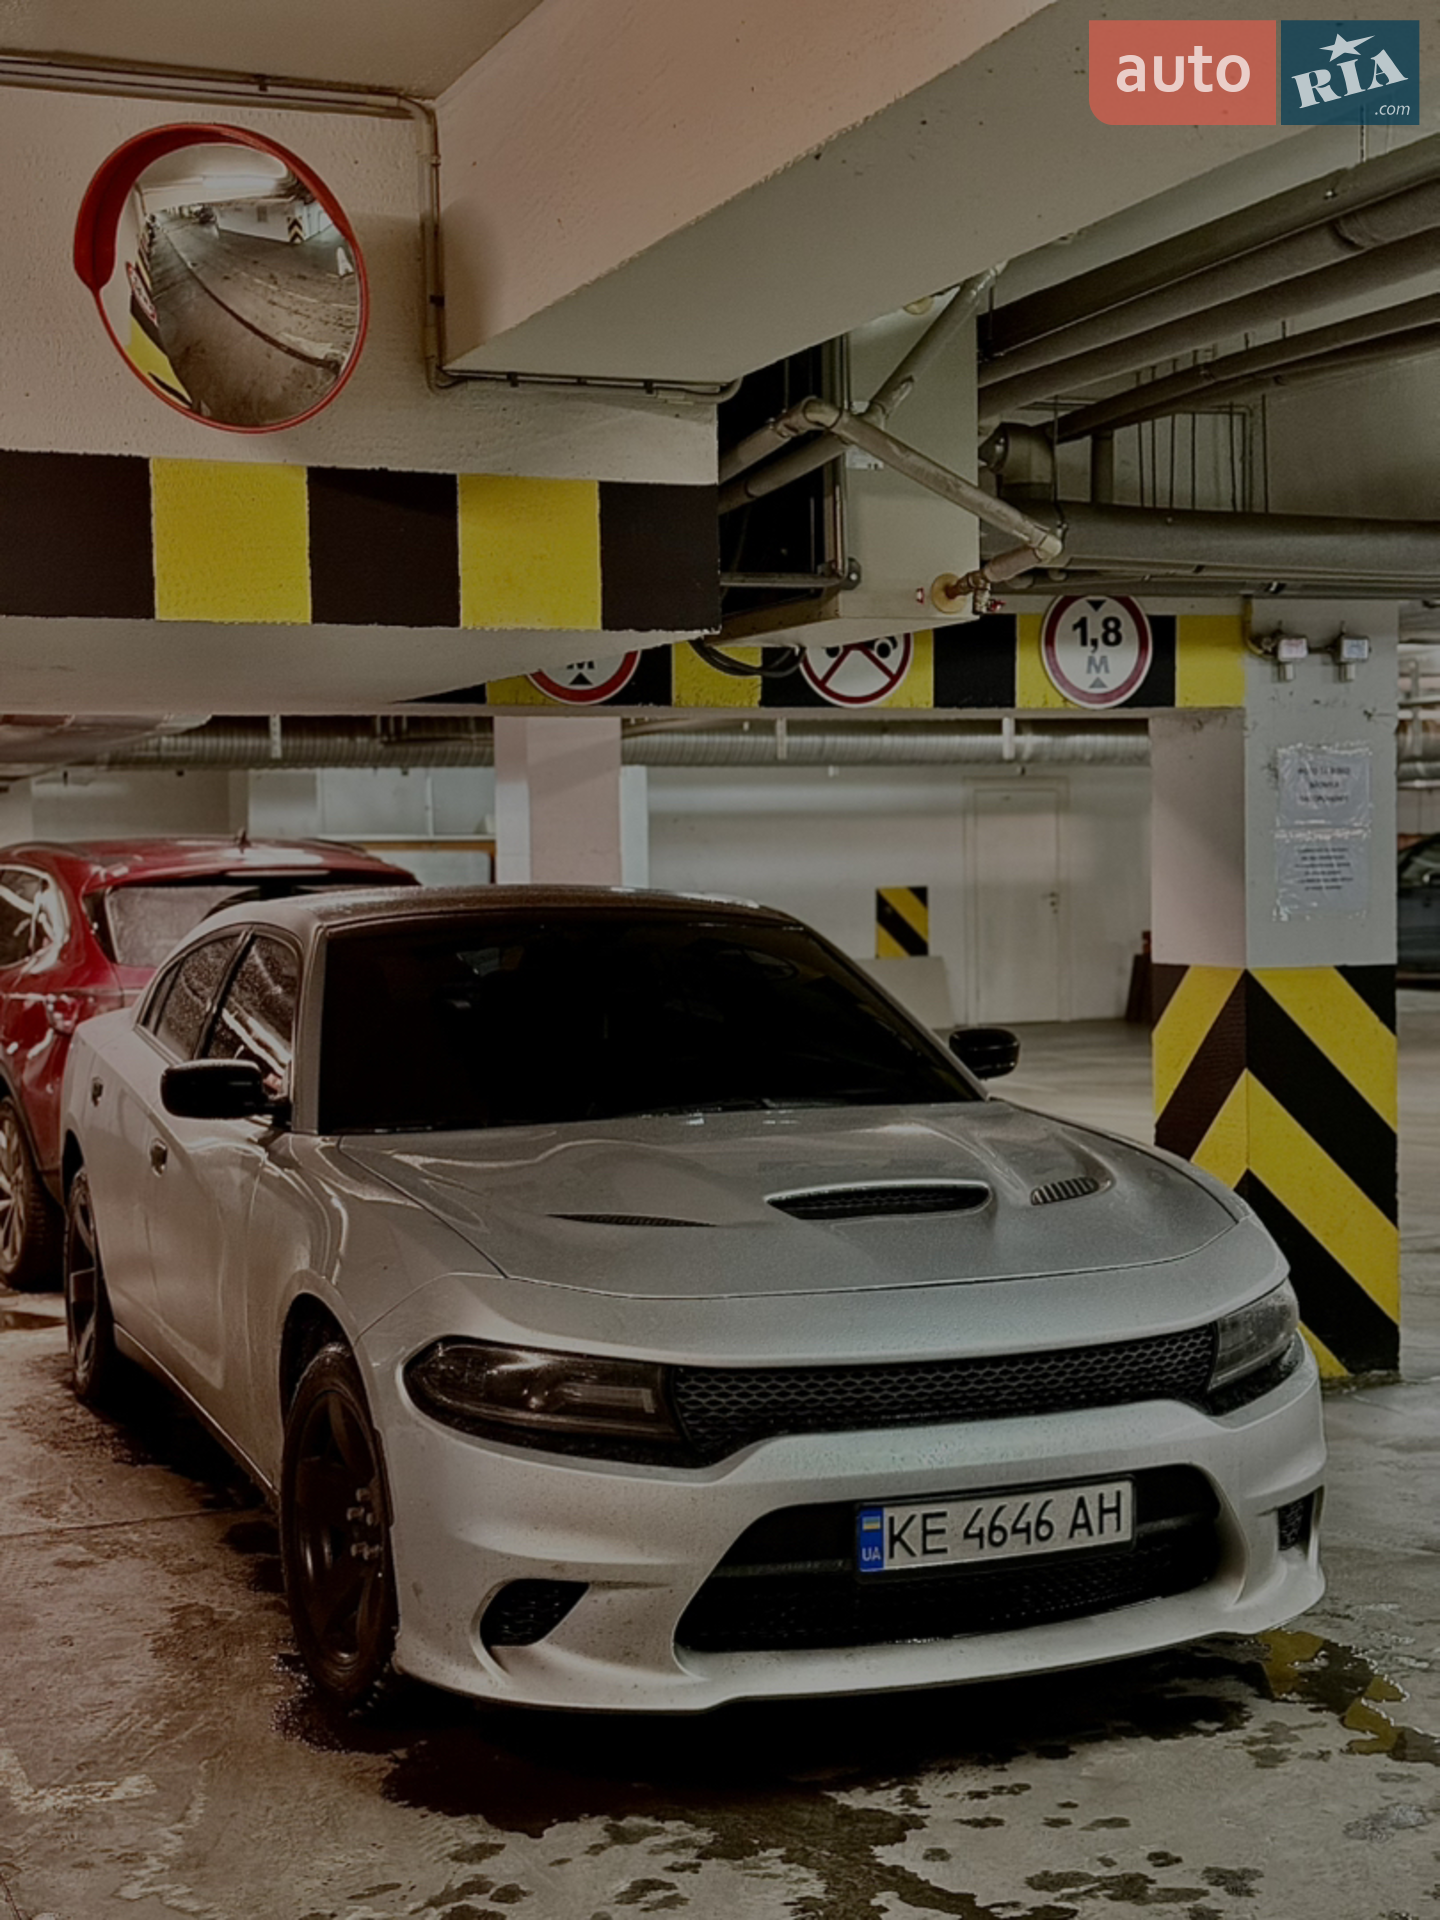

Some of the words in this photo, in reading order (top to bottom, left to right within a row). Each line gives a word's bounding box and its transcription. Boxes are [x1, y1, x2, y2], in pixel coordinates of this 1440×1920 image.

[1072, 615, 1123, 654] 1,8
[888, 1510, 948, 1559] KE
[963, 1499, 1054, 1549] 4646
[1068, 1490, 1121, 1539] AH
[861, 1547, 881, 1562] UA
